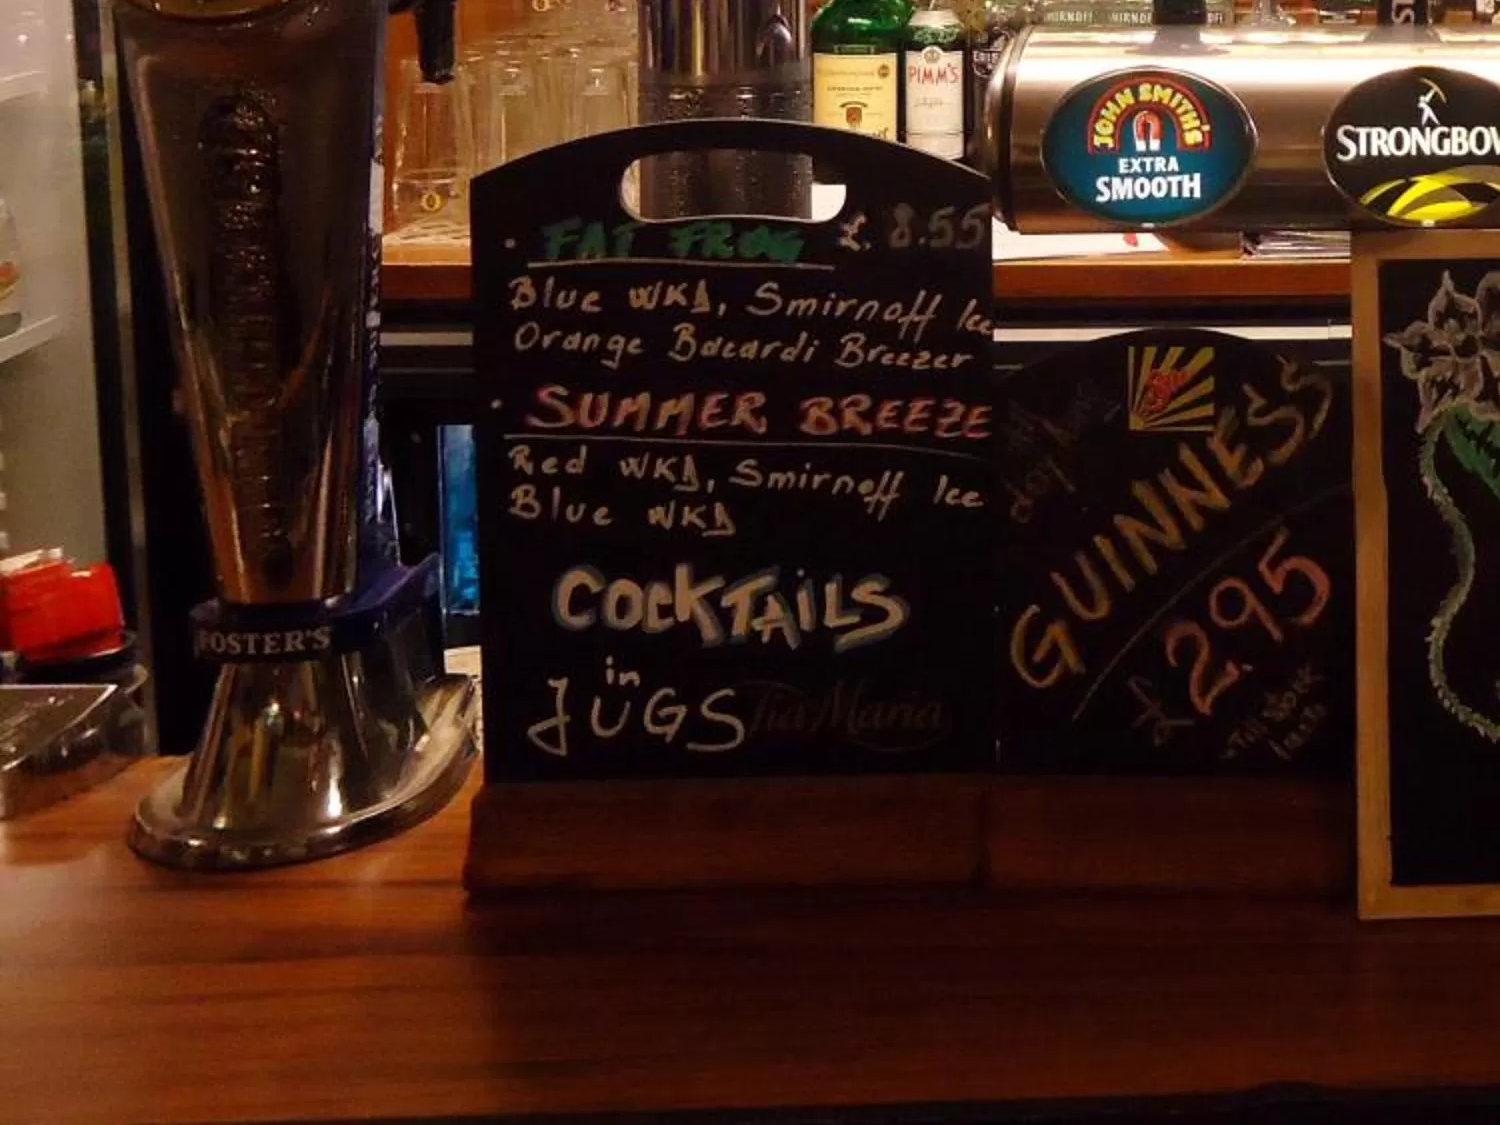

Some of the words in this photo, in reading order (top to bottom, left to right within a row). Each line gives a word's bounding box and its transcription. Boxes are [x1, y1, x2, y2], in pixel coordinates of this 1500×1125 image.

[907, 62, 960, 84] PIMM'S
[1093, 87, 1136, 149] JOHN
[1138, 81, 1207, 147] SMITH'S
[1095, 172, 1201, 203] SMOOTH
[1118, 156, 1180, 174] EXTRA
[541, 218, 634, 262] FAT
[507, 277, 604, 315] Blue
[746, 281, 944, 341] Smirnoff
[513, 322, 645, 369] Orange
[669, 322, 816, 364] Bacardi
[833, 334, 976, 371] Breezer
[526, 383, 769, 437] SUMMER
[800, 395, 994, 441] BREEZE
[506, 442, 587, 479] Red
[729, 458, 906, 521] Smirnoff
[932, 474, 985, 509] Ice
[507, 483, 615, 527] Blue
[1008, 353, 1334, 691] GUINNESS
[605, 655, 642, 688] in
[526, 677, 747, 756] JUGS
